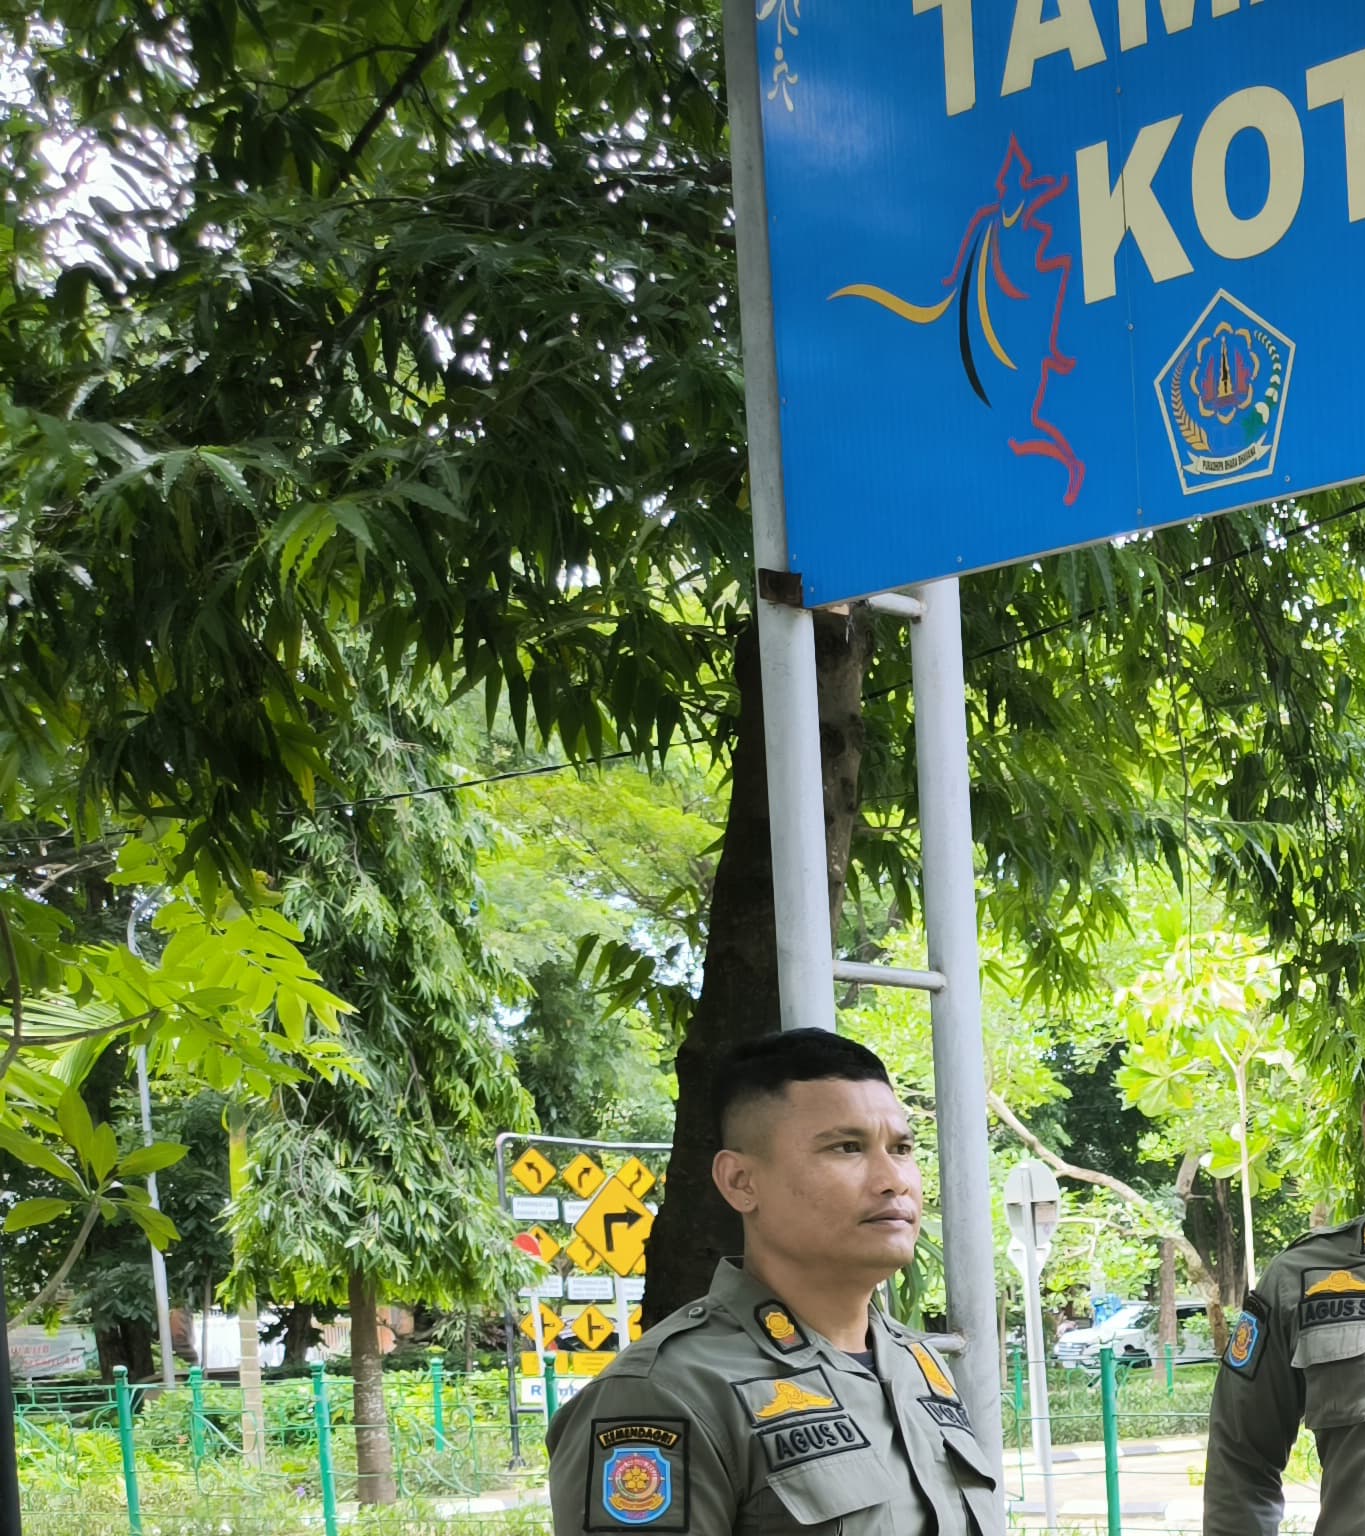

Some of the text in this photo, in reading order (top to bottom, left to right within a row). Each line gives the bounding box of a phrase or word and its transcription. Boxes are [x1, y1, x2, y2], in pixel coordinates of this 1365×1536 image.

[1305, 1301, 1355, 1323] AGUS
[774, 1420, 856, 1460] AGUS D
